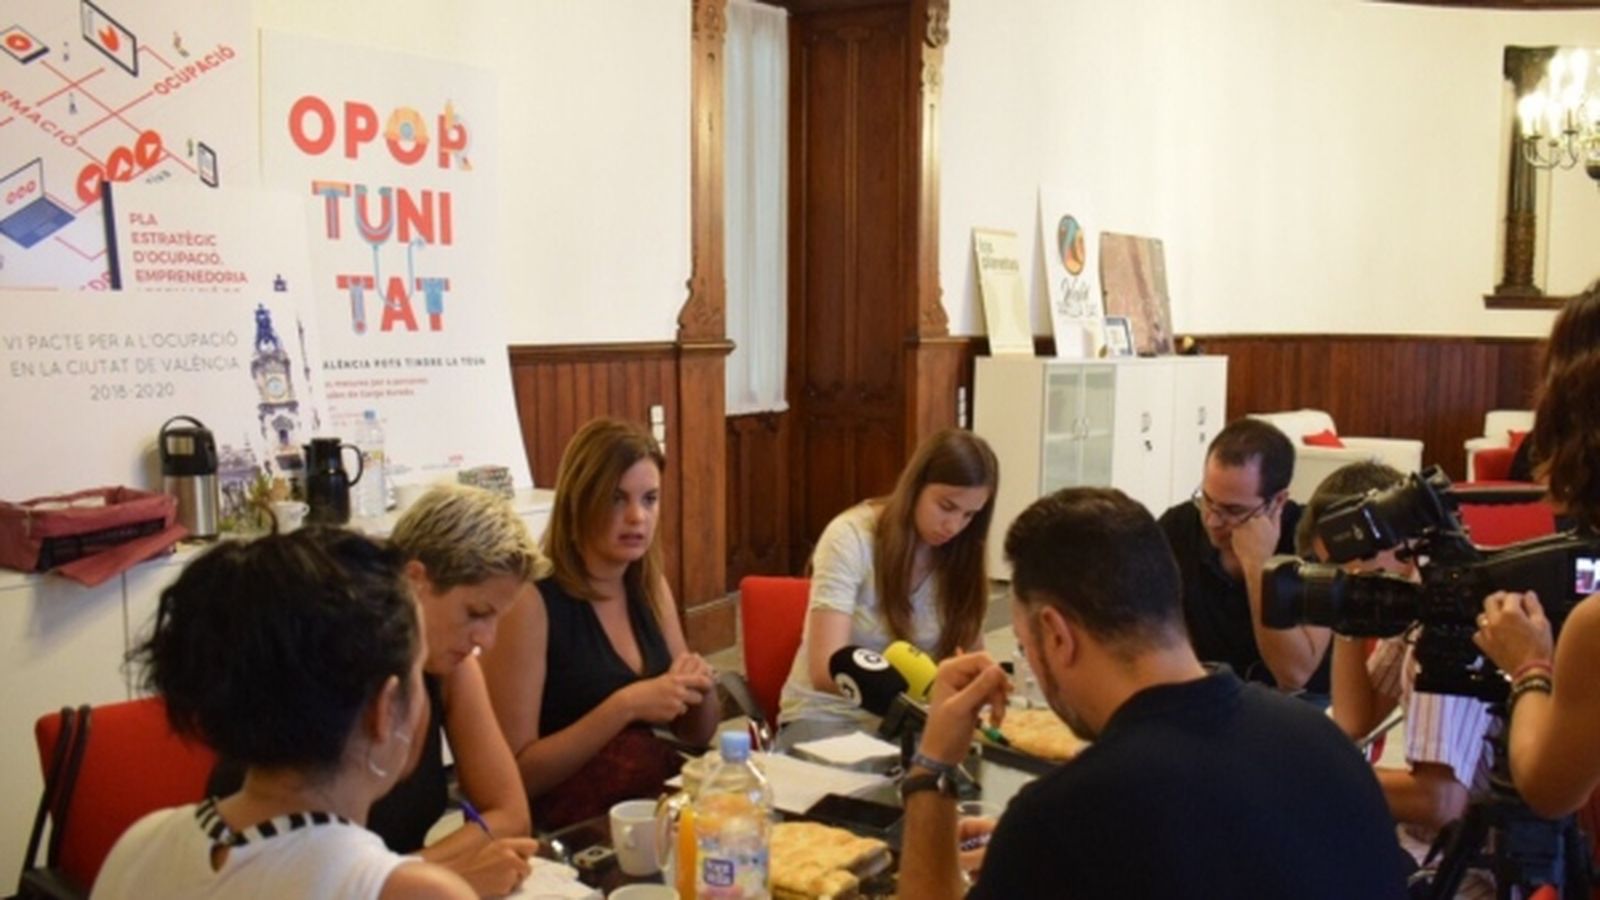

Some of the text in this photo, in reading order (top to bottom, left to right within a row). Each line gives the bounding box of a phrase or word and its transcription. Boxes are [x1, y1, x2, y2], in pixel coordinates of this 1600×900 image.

[153, 43, 236, 96] OCUPACIÓ
[288, 95, 472, 171] OPOR
[129, 212, 158, 226] PLA
[311, 180, 453, 246] TUNI
[130, 230, 217, 247] ESTRATÈGIC
[135, 269, 249, 284] EMPRENEDORIA
[336, 274, 450, 335] TAT
[3, 329, 239, 351] VI PACTE PER A L'OCUPACIÓ
[10, 359, 35, 378] EN
[39, 360, 63, 377] LA
[66, 358, 129, 376] CIUTAT
[136, 357, 158, 375] DE
